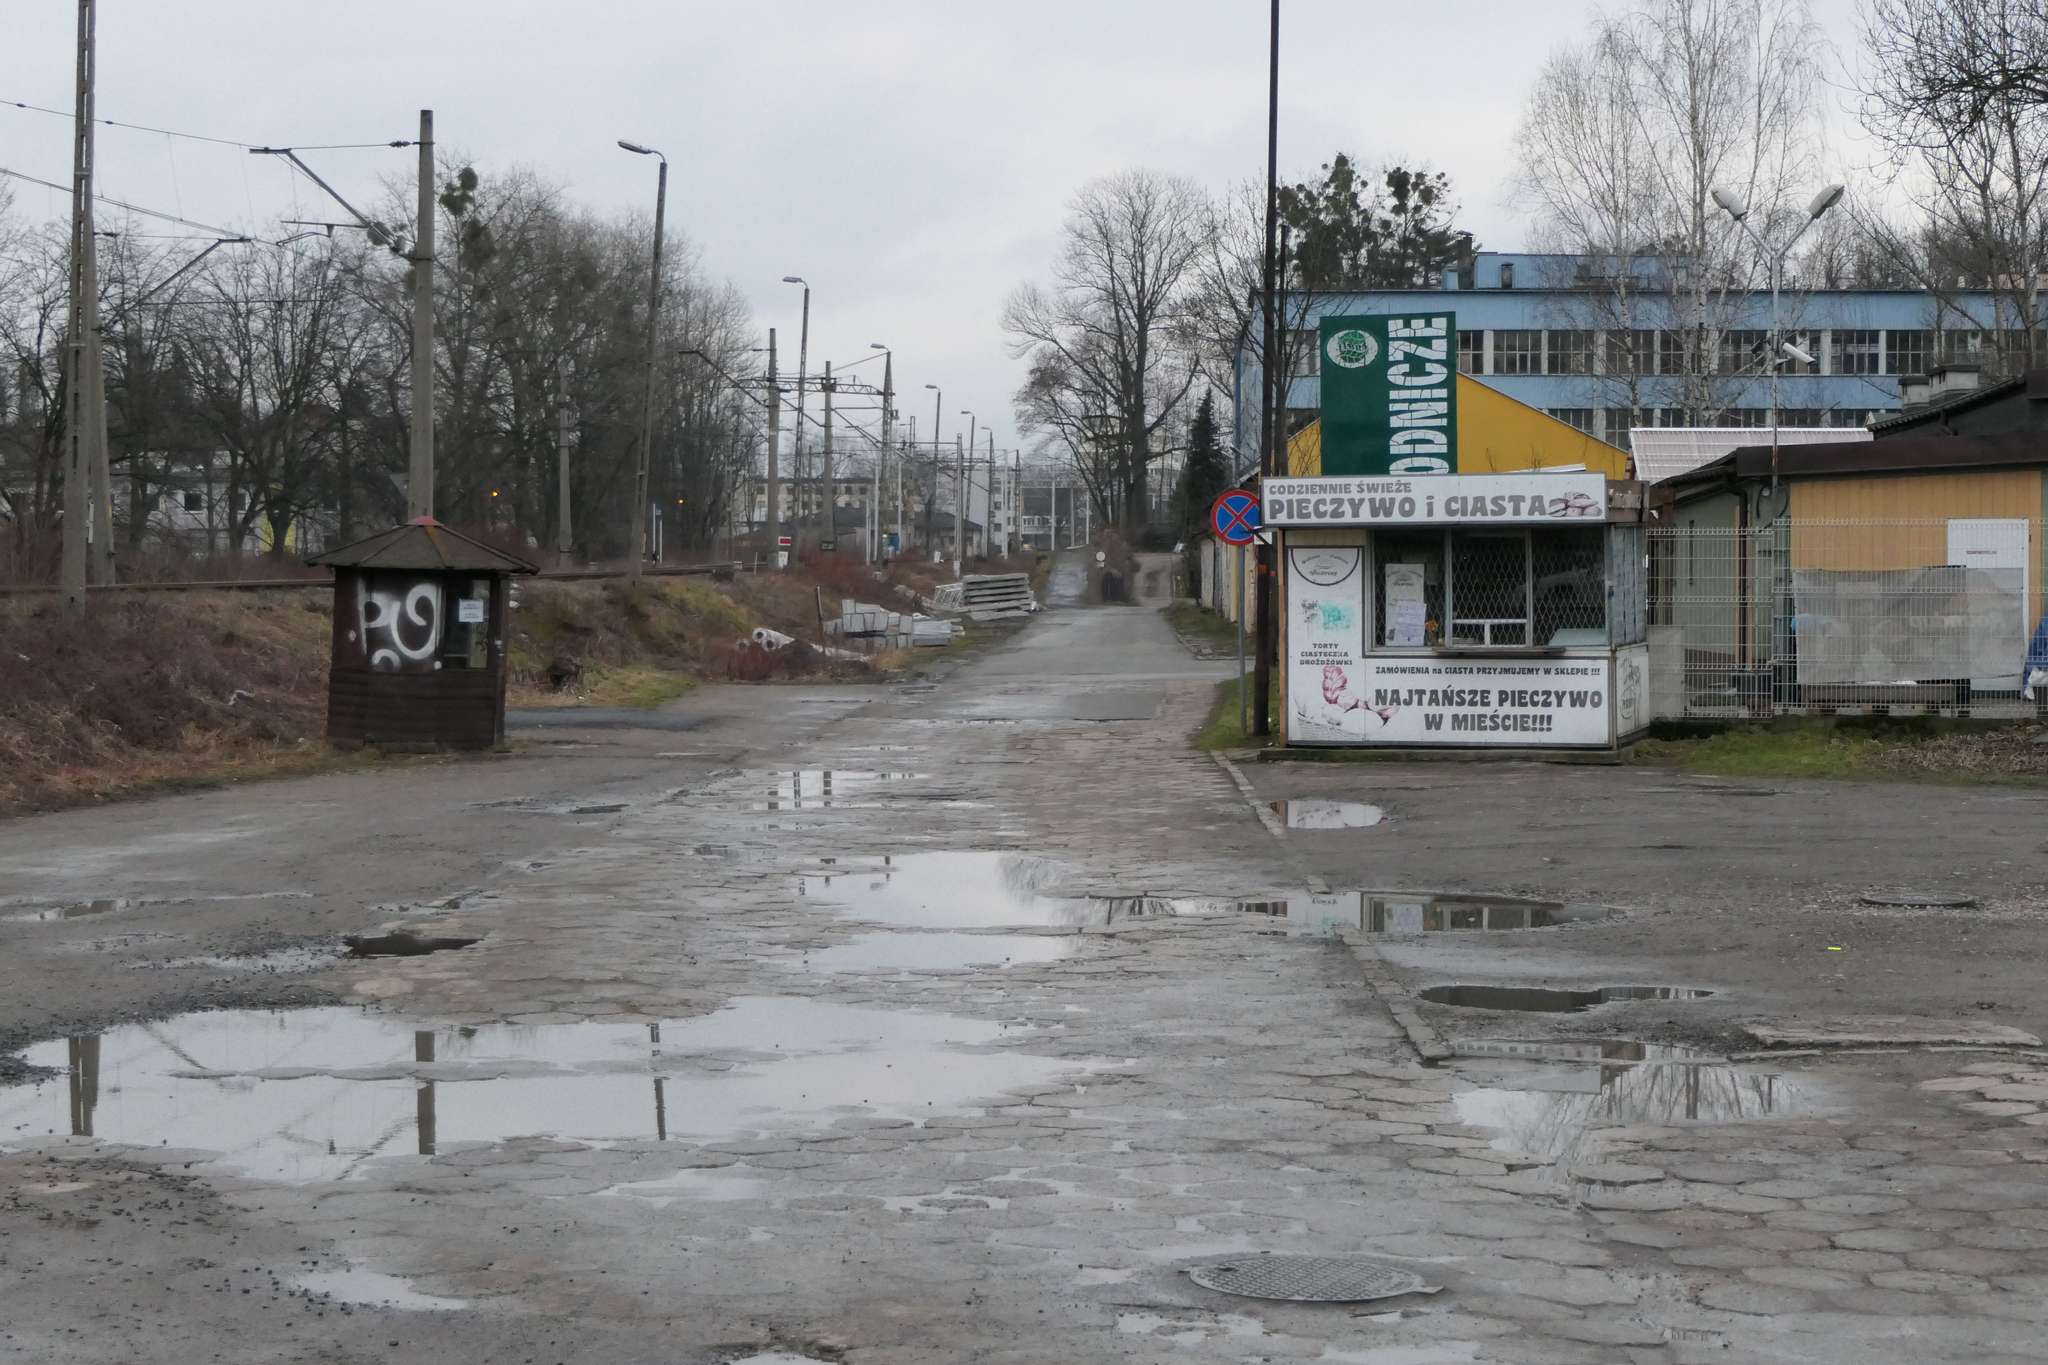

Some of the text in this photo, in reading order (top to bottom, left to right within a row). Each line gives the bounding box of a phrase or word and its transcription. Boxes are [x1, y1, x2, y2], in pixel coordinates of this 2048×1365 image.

[1269, 480, 1412, 496] CODZIENNIE ŚWIEŻE
[1269, 494, 1546, 520] PIECZYWO i CIASTA
[1375, 665, 1430, 675] ZAMÓWIENIA
[1444, 666, 1474, 675] CIASTA
[1476, 667, 1540, 676] PRZYJMUJEMY
[1543, 667, 1552, 675] W
[1554, 667, 1589, 676] SKLEPIE
[1375, 684, 1603, 708] NAJTAŃSZE PIECZYWO
[1424, 709, 1553, 732] W MIEŚCIE!!!
